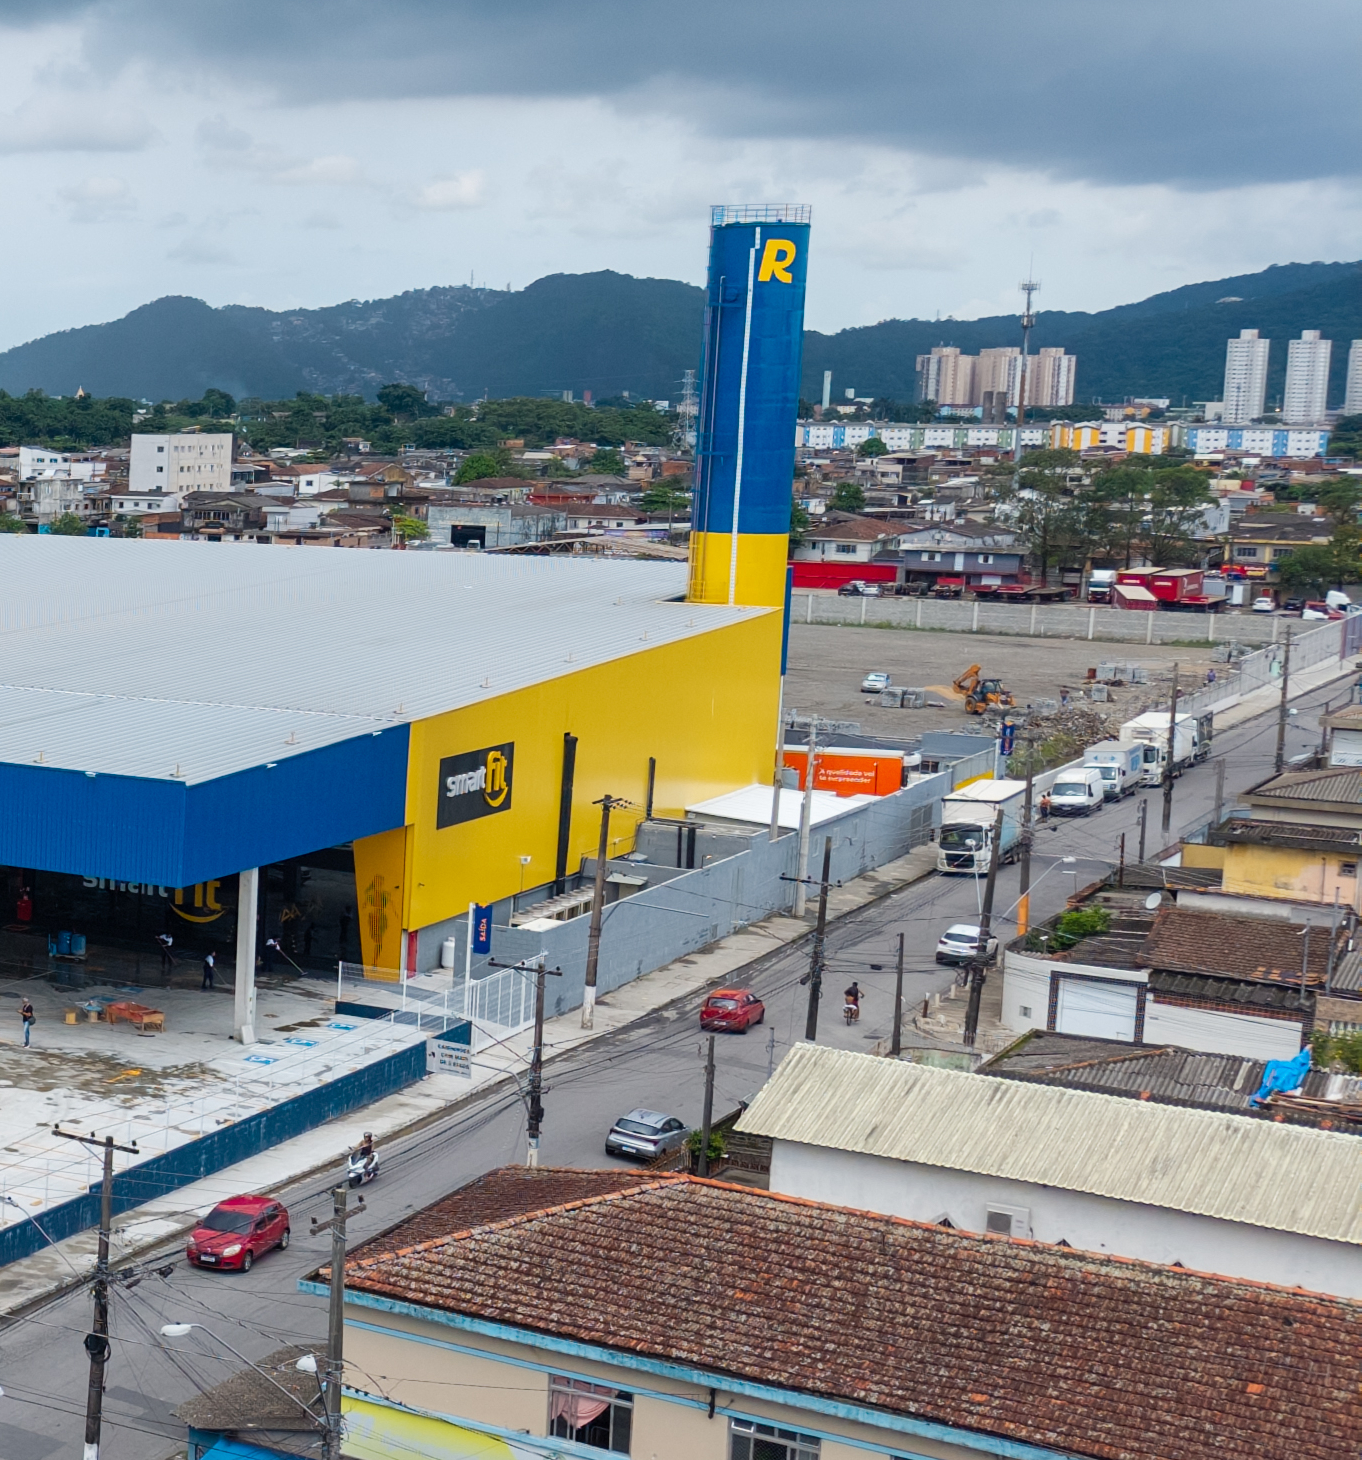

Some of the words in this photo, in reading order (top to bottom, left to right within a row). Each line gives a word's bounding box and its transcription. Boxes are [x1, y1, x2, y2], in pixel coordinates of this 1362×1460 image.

[757, 238, 797, 284] R
[446, 765, 486, 798] smart
[485, 750, 508, 793] fit
